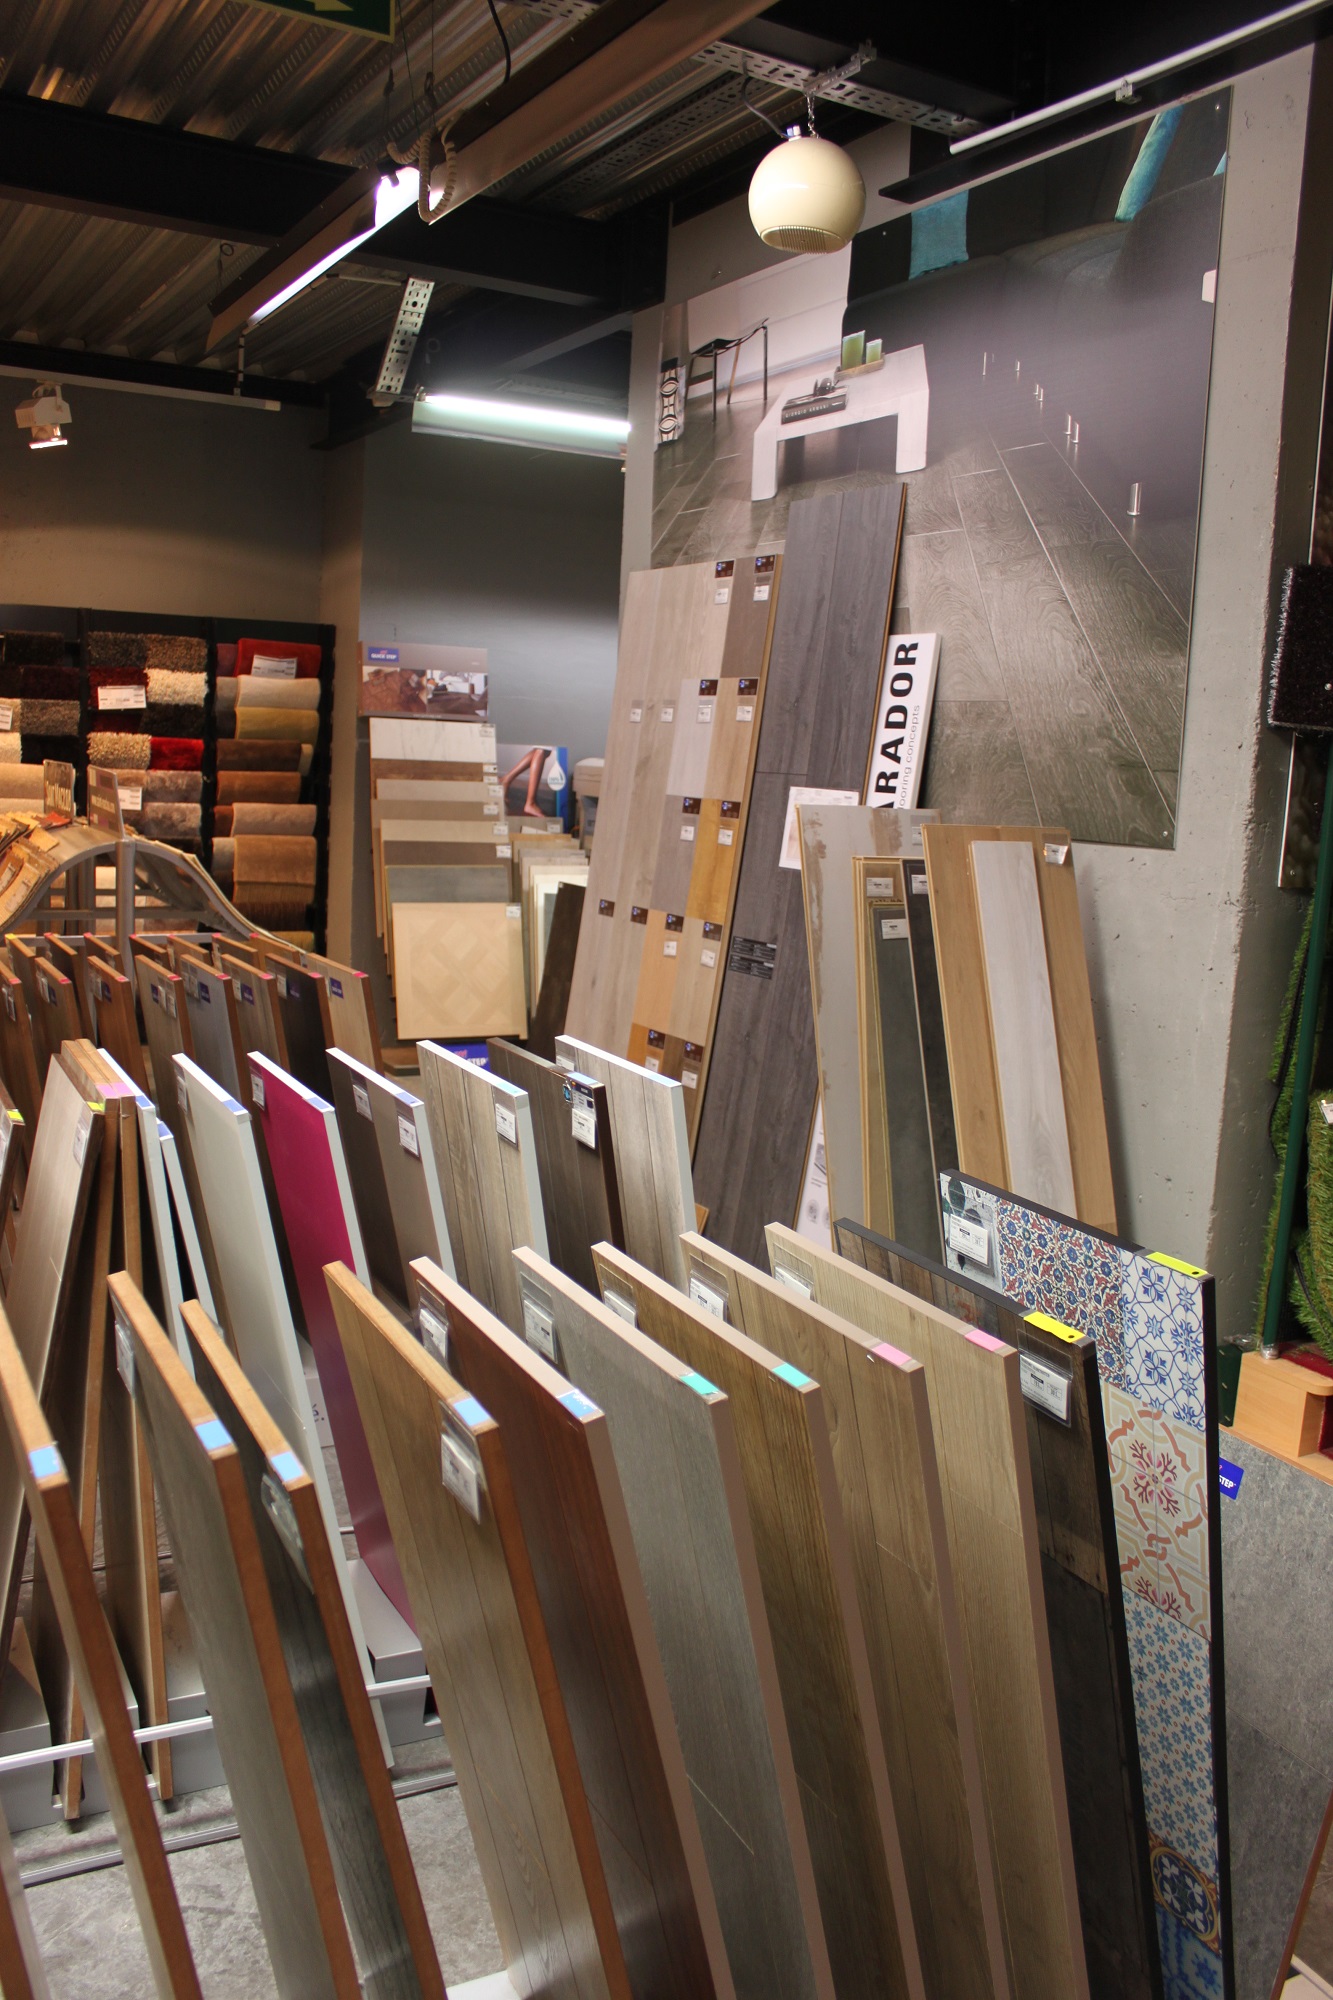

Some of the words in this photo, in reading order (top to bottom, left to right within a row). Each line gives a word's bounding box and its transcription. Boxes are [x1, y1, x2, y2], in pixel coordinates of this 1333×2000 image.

[785, 409, 807, 419] GIORGIO
[809, 404, 829, 412] ARMANI
[874, 642, 919, 808] RADOR
[905, 704, 921, 763] concepts
